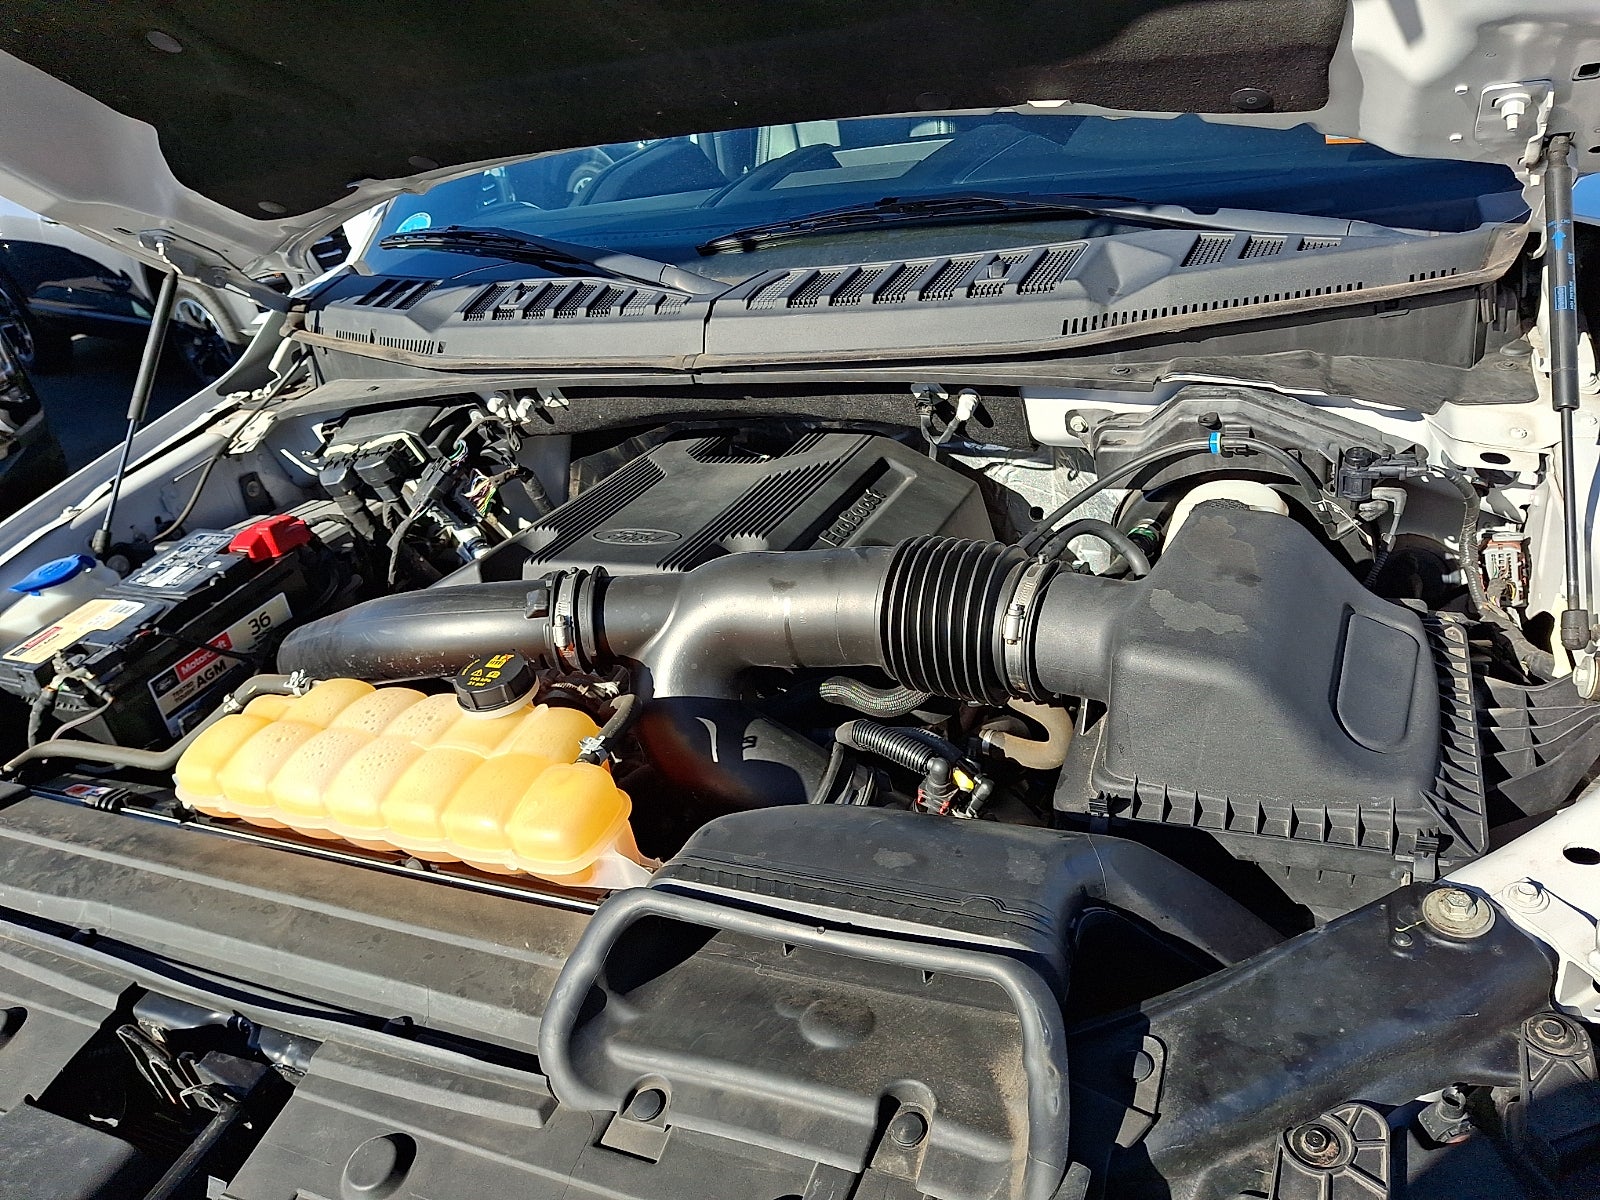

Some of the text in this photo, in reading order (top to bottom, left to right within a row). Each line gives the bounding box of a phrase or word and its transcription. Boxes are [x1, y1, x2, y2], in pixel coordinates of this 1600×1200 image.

[818, 488, 887, 547] EcoBoost
[248, 611, 271, 636] 36
[180, 640, 227, 675] Motorcft
[196, 659, 228, 689] AGM
